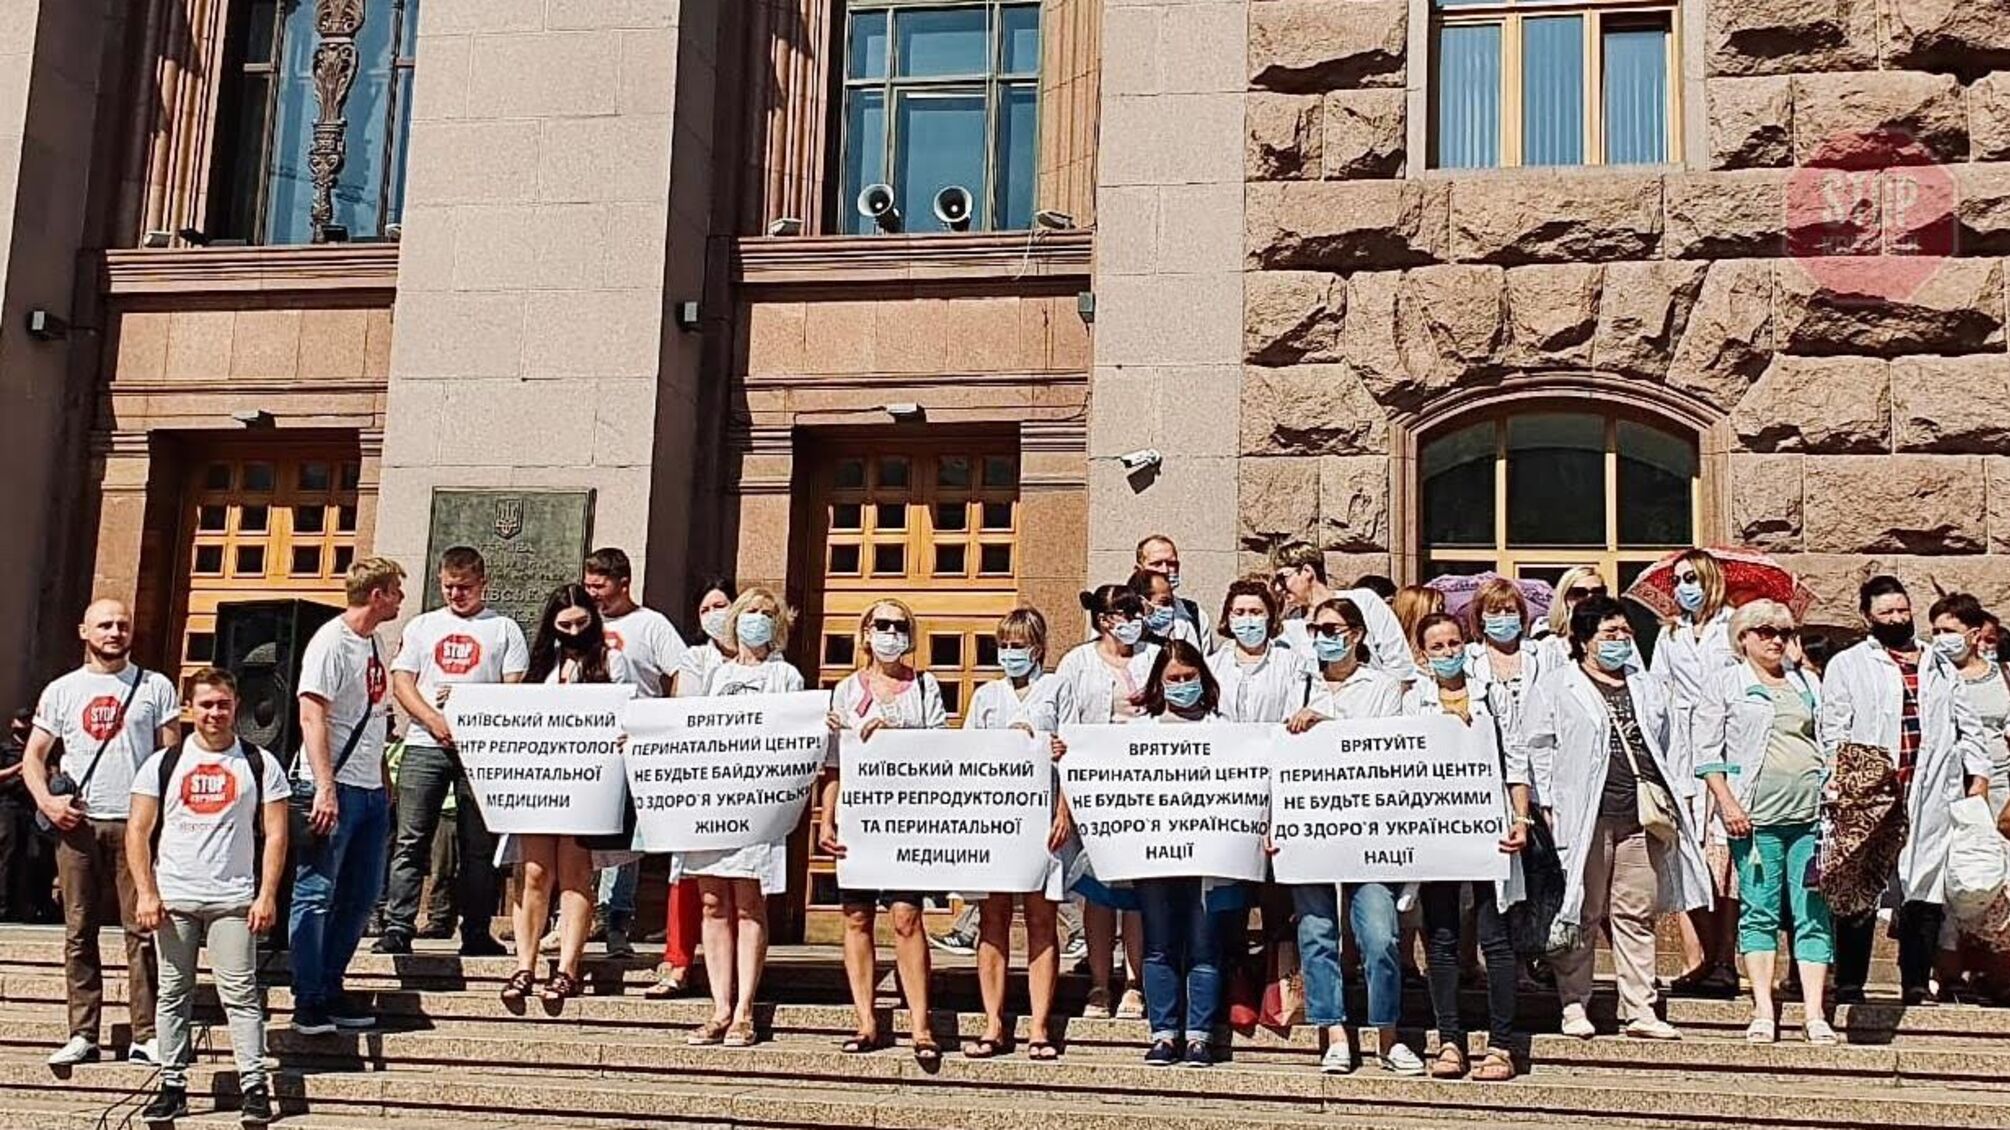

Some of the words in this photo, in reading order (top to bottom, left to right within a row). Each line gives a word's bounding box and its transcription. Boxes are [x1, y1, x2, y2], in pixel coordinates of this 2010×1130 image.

[443, 641, 472, 658] STOP
[458, 713, 542, 727] КИЇВСЬКИЙ
[548, 712, 615, 727] МІСЬКИЙ
[688, 712, 762, 727] ВРЯТУЙТЕ
[455, 740, 486, 753] НТР
[489, 740, 622, 756] РЕПРОДУКТОЛОГ
[632, 738, 760, 755] ПЕРИНАТАЛЬНИЙ
[766, 737, 822, 756] ЦЕНТР!
[1130, 740, 1210, 755] ВРЯТУЙТЕ
[1342, 734, 1426, 752] ВРЯТУЙТЕ
[477, 765, 602, 781] ПЕРИНАТАЛЬНОЇ
[635, 769, 651, 782] НЕ
[655, 767, 708, 783] БУДЬТЕ
[712, 759, 819, 784] БАЙДУЖИМИ
[859, 760, 953, 776] КИЇВСЬКИЙ
[959, 760, 1034, 777] МІСЬКИЙ
[1068, 766, 1210, 781] ПЕРИНАТАЛЬНИЙ
[1280, 761, 1427, 783] ПЕРИНАТАЛЬНИЙ
[1433, 763, 1492, 780] ЦЕНТР!
[191, 774, 226, 793] STOP
[487, 794, 569, 809] МЕДИЦИНИ
[636, 796, 644, 809] О
[842, 791, 894, 807] ЦЕНТР
[898, 790, 1049, 807] РЕПРОДУКТОЛОГІЇ
[1073, 795, 1091, 809] НЕ
[1096, 794, 1154, 808] БУДЬТЕ
[1159, 789, 1271, 811] БАЙДУЖИМИ
[1285, 797, 1305, 809] НЕ
[1311, 794, 1370, 811] БУДЬТЕ
[1376, 790, 1491, 809] БАЙДУЖИМИ
[695, 819, 749, 833] ЖІНОК
[861, 820, 881, 833] ТА
[885, 818, 1022, 834] ПЕРИНАТАЛЬНОЇ
[1079, 823, 1088, 836] О
[1275, 824, 1299, 840] ДО
[1386, 817, 1502, 835] УКРАЇНСЬКОЇ
[897, 849, 989, 866] МЕДИЦИНИ
[1146, 842, 1194, 860] НАЦІЇ
[1365, 847, 1414, 866] НАЦІЇ
